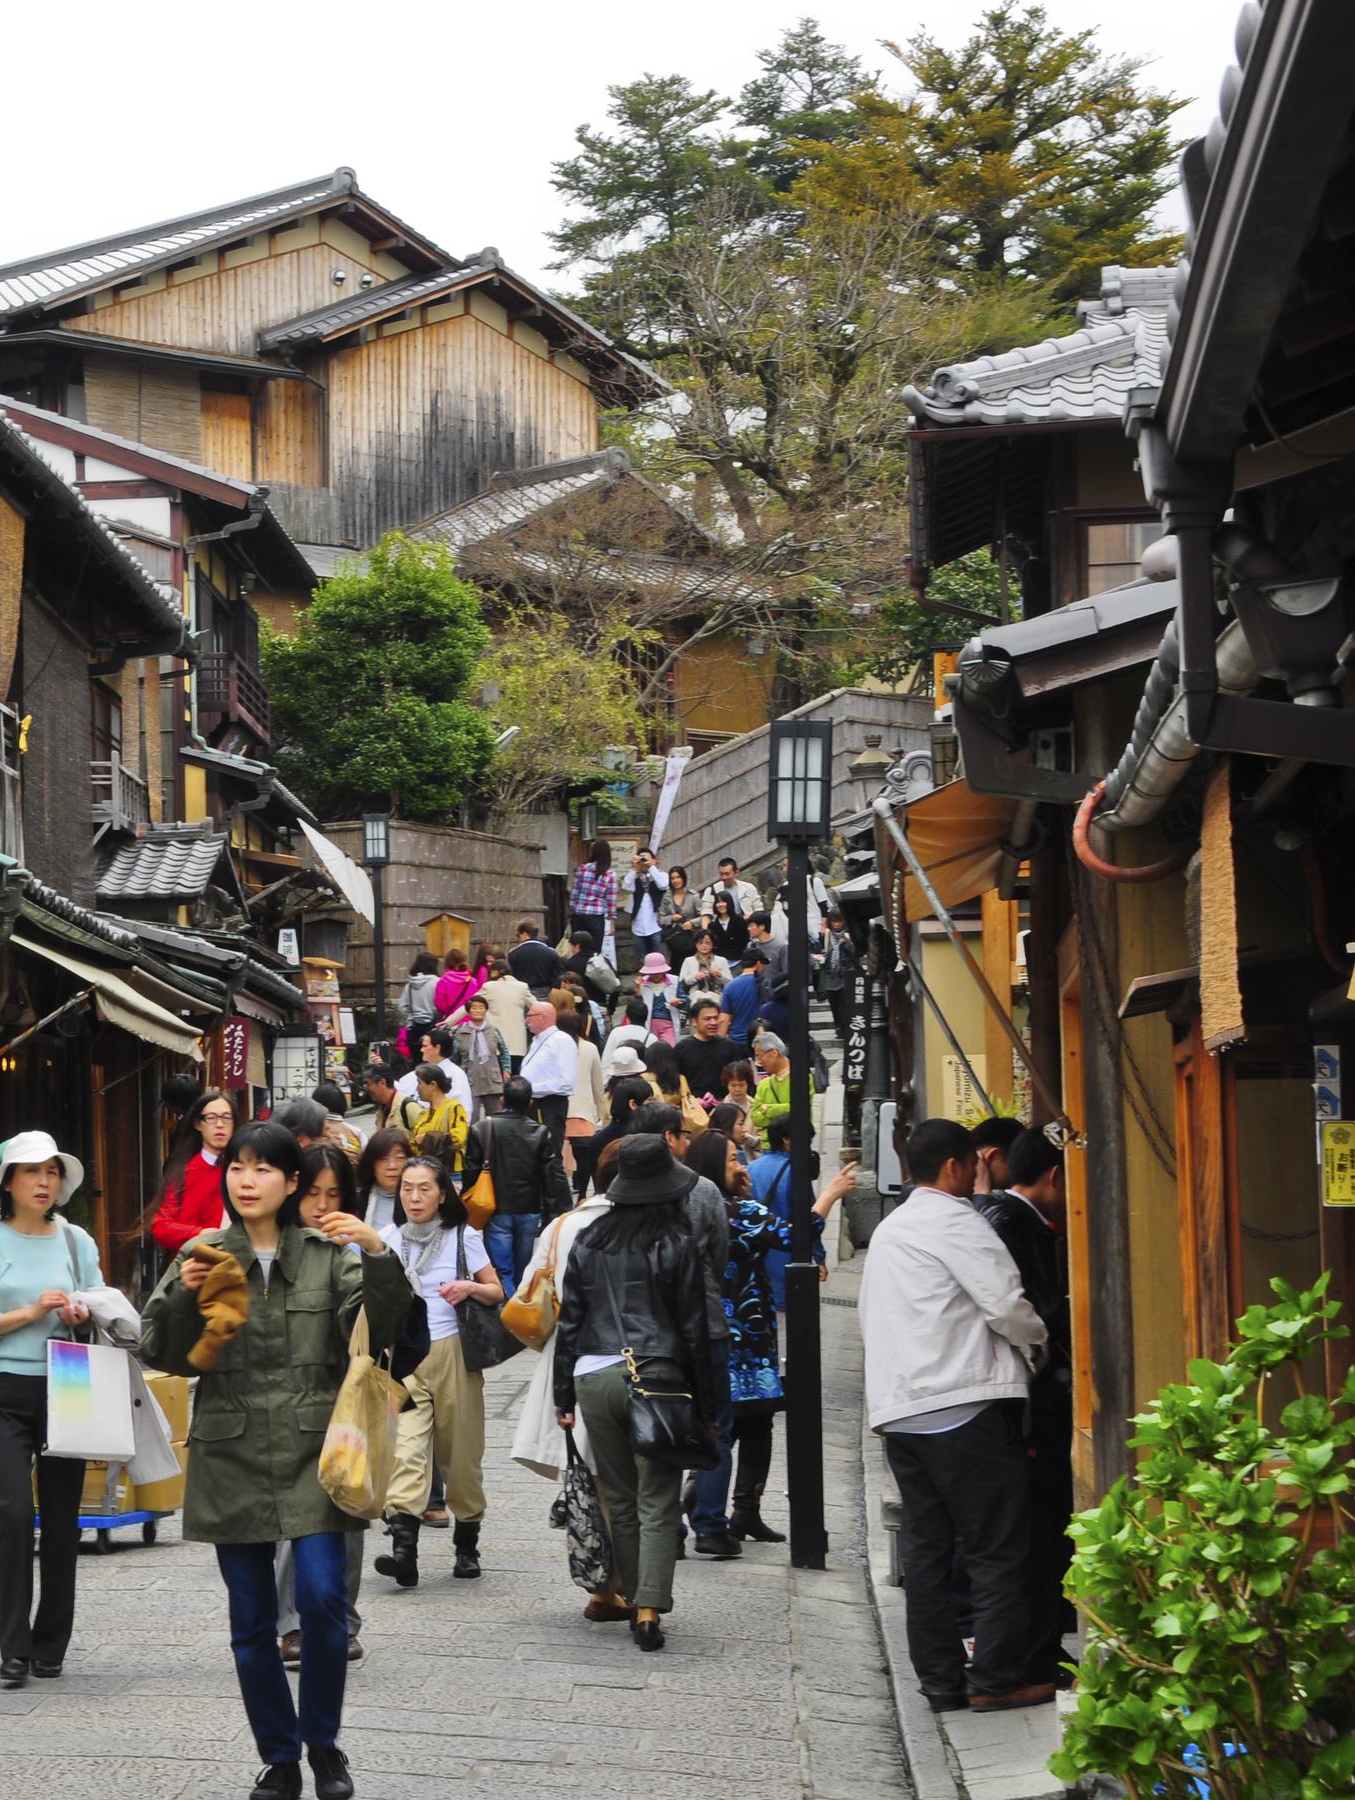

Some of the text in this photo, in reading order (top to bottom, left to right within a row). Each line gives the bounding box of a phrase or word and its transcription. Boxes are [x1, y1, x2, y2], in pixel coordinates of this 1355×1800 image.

[233, 1024, 245, 1076] みたらし
[848, 1015, 866, 1080] きんつば
